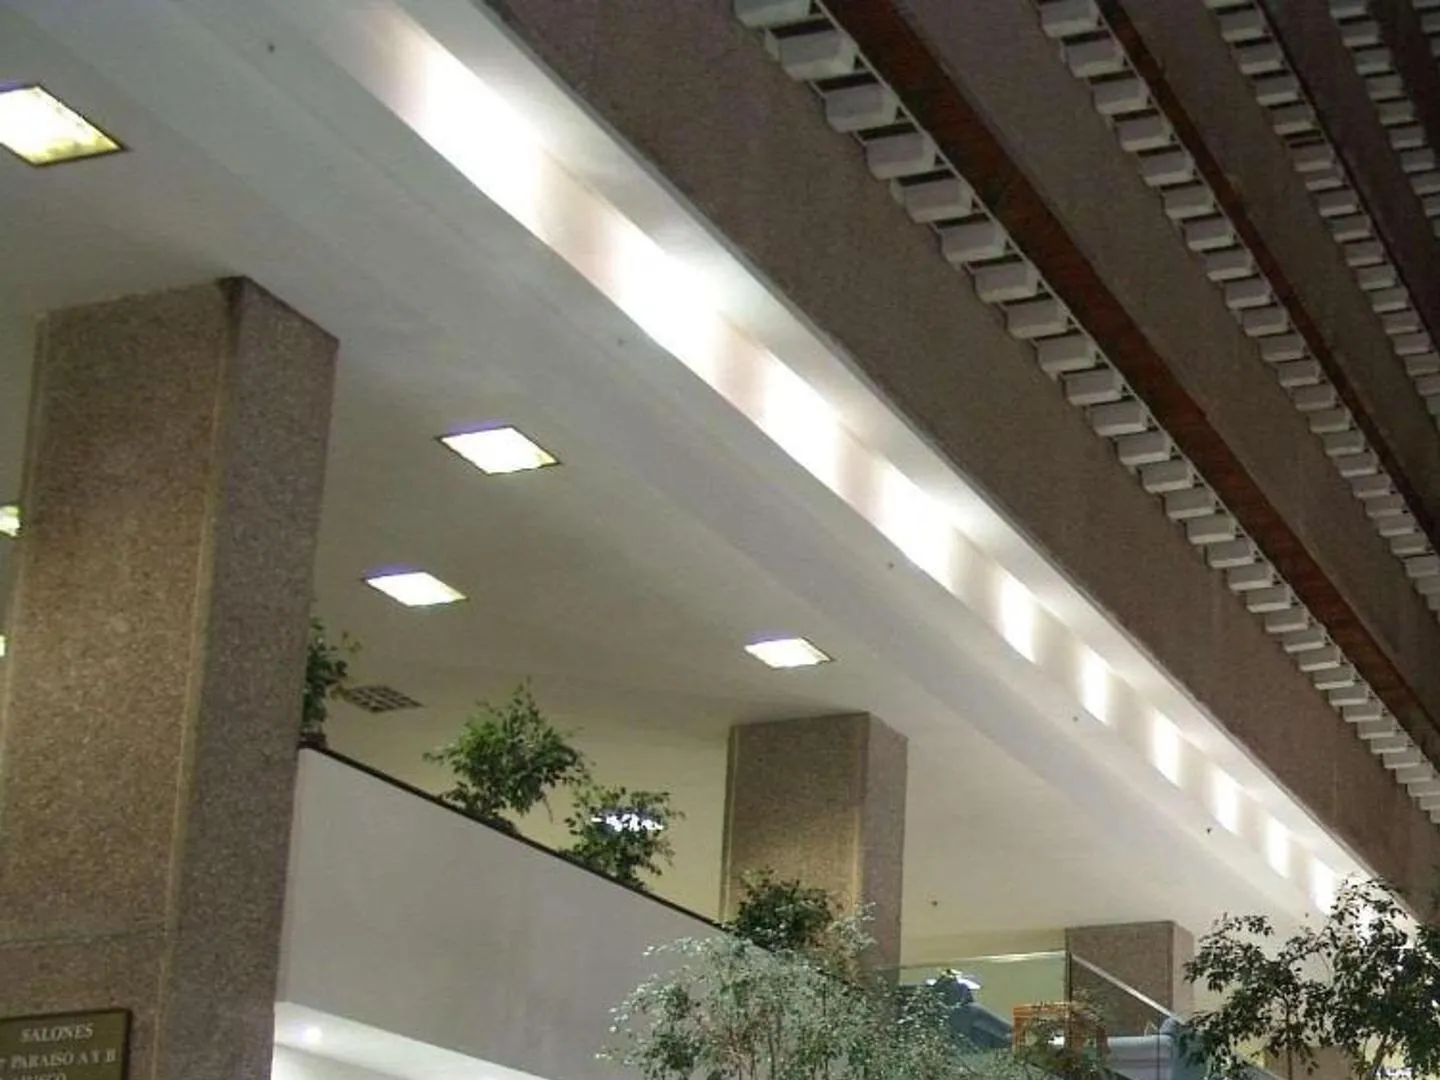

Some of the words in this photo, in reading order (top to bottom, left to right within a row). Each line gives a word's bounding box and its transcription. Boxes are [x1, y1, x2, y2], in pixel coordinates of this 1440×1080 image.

[21, 1023, 94, 1042] SALONES
[10, 1051, 74, 1069] PARAISO
[77, 1051, 89, 1065] A
